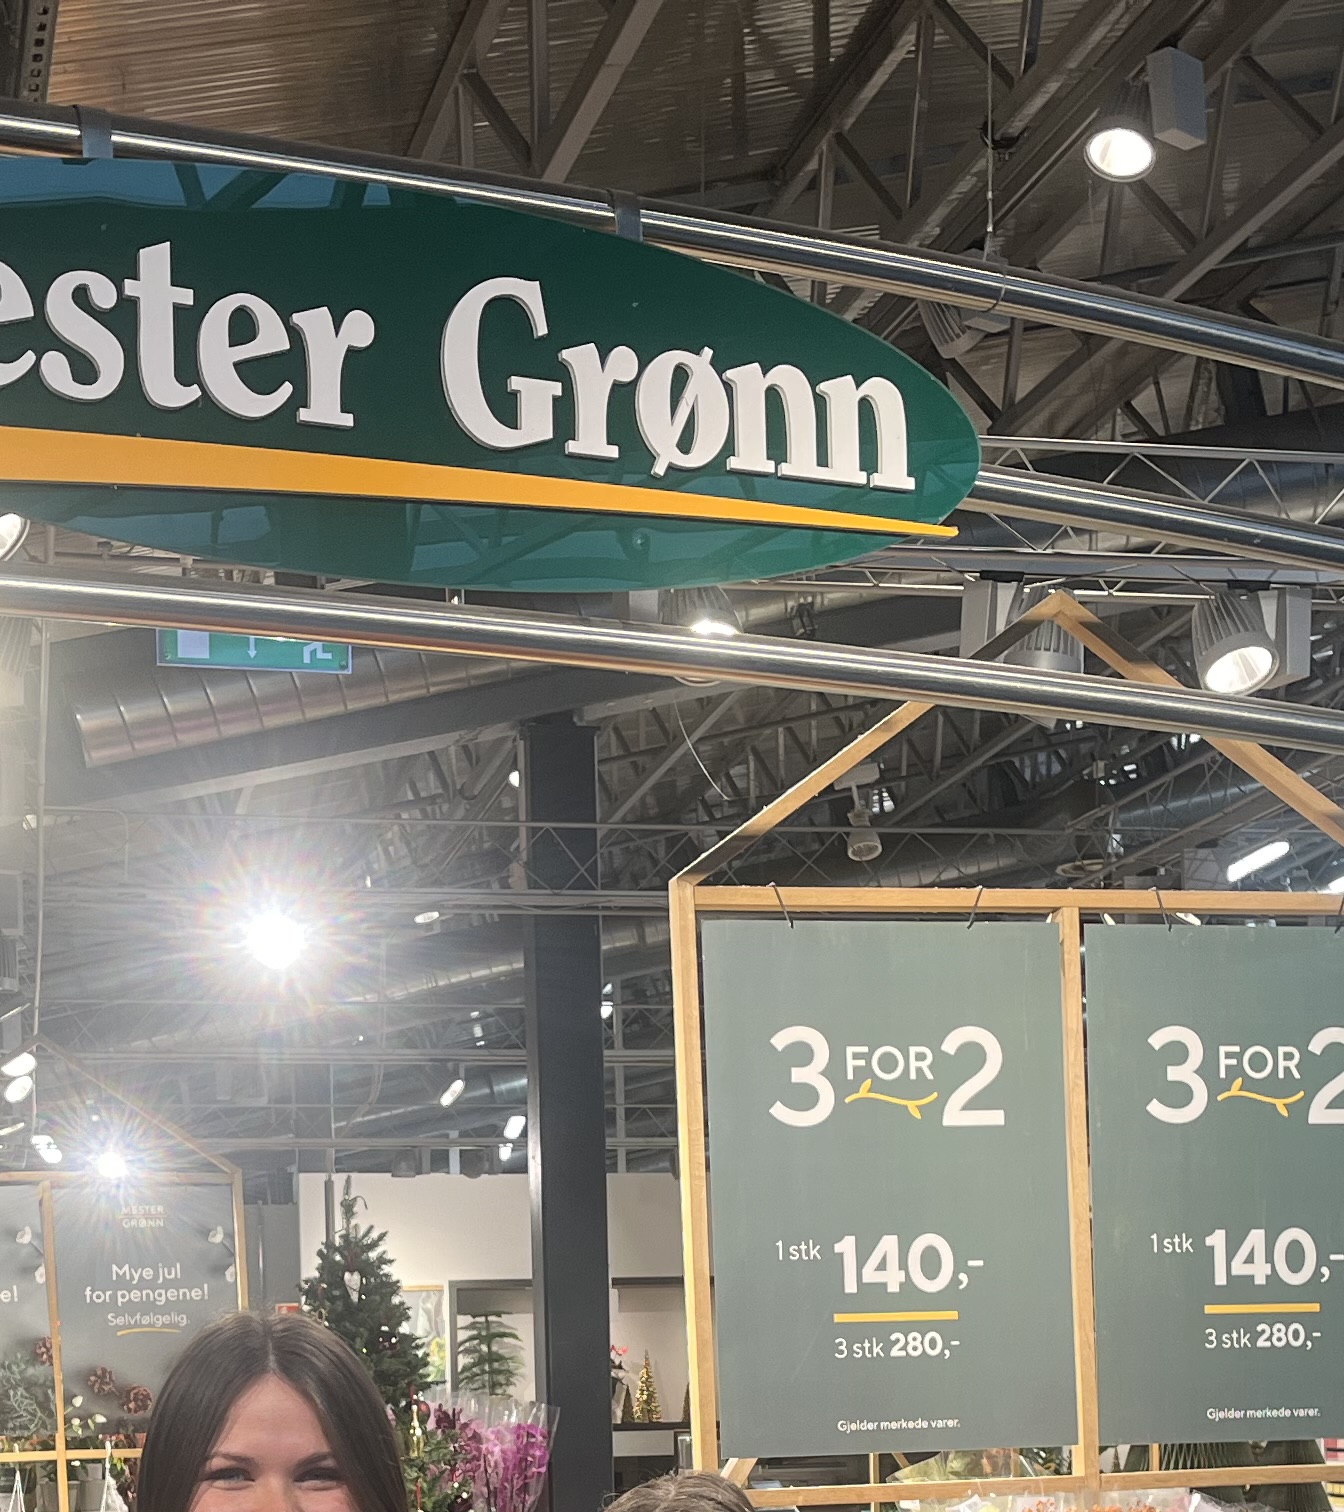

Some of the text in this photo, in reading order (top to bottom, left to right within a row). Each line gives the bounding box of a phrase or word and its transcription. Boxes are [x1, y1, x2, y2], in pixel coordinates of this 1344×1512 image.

[442, 276, 915, 490] Grønn
[769, 1025, 1006, 1127] 3 FOR 2
[1145, 1025, 1209, 1124] 3
[1219, 1045, 1301, 1080] FOR
[121, 1205, 165, 1216] MESTER
[122, 1217, 165, 1228] GRØNN
[112, 1262, 181, 1285] Mye jul
[833, 1232, 984, 1294] 140,-
[84, 1283, 209, 1306] for pengene!
[108, 1311, 191, 1327] Selvfølgelig.
[834, 1332, 961, 1360] 3 stk 280,-
[1204, 1323, 1322, 1351] 3 stk 280,-
[1207, 1406, 1321, 1421] Gjelder merkede varer.
[837, 1418, 961, 1433] Gjelder merkede varer.
